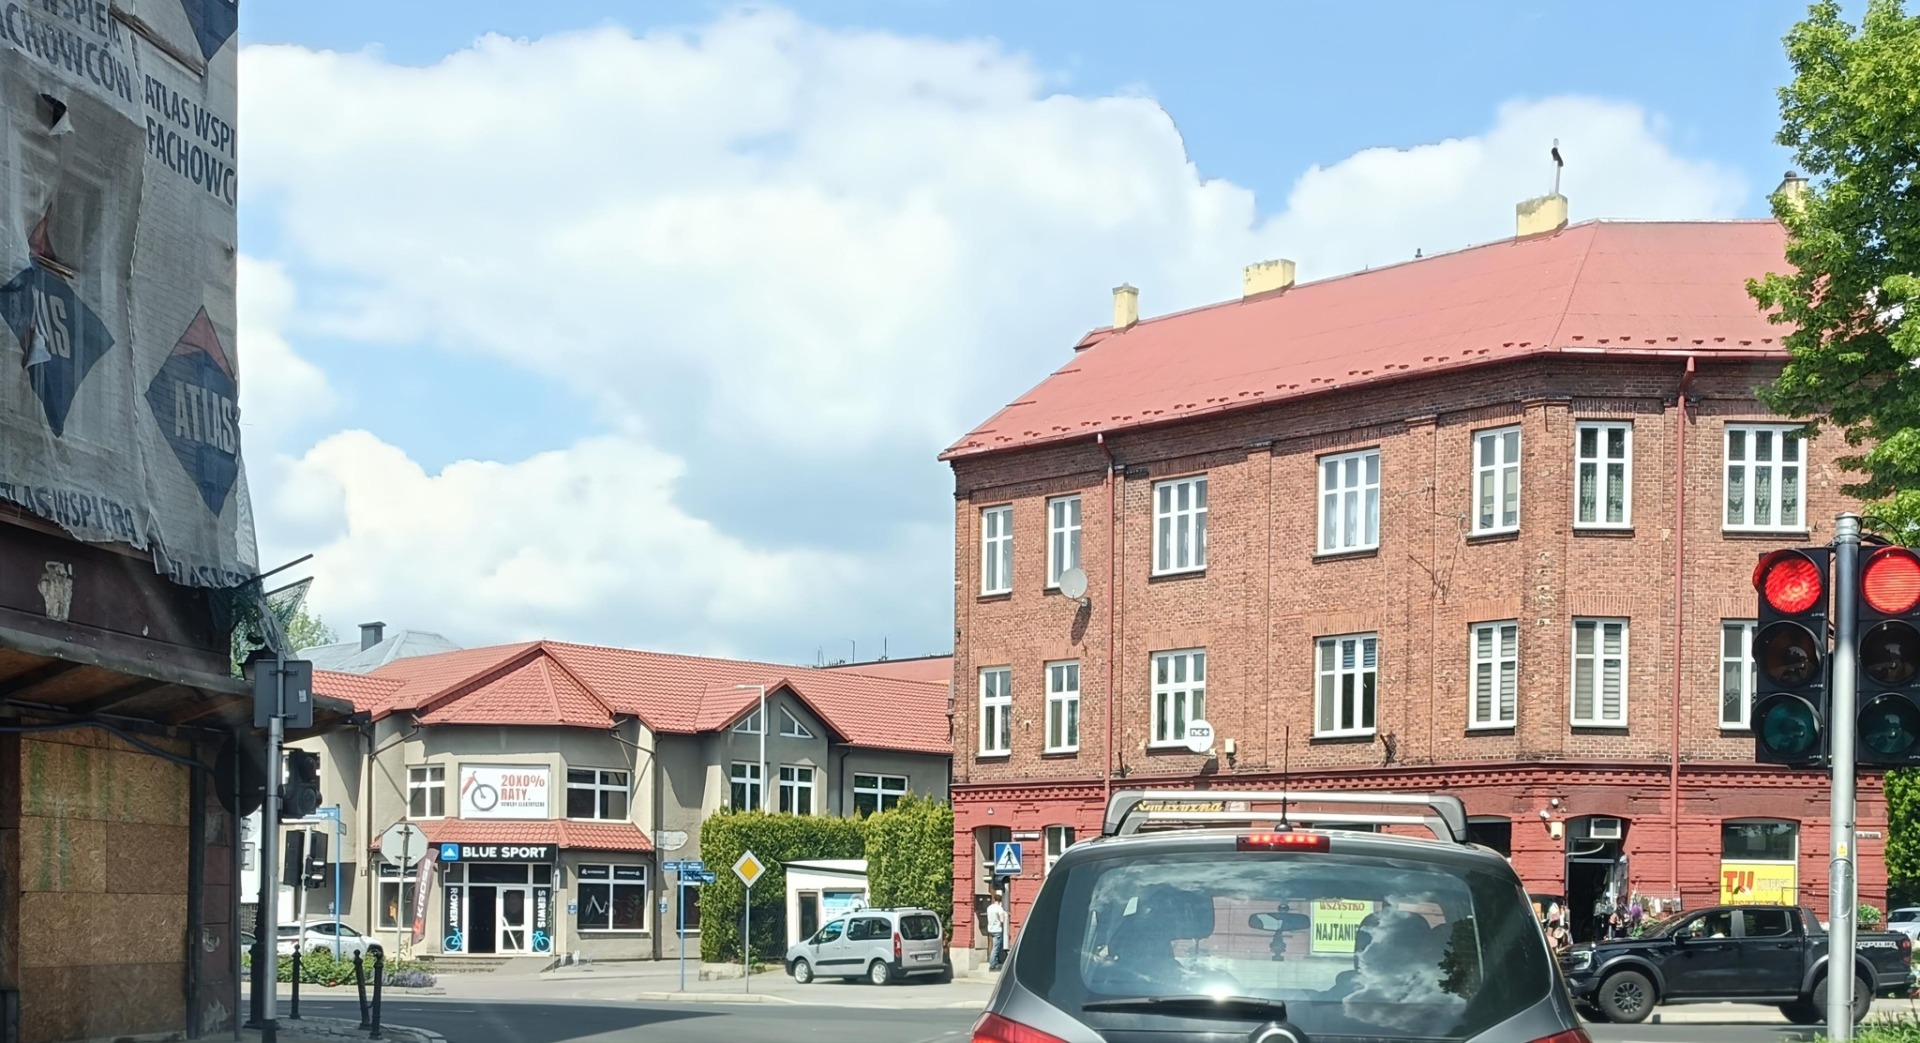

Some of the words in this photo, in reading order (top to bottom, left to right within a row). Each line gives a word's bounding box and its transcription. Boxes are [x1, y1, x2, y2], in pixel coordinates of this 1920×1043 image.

[145, 74, 190, 129] ATLAS
[146, 115, 237, 206] FACHOWC
[175, 381, 236, 455] ATLAS
[462, 846, 497, 858] BLUE
[501, 847, 547, 858] SPORT
[416, 858, 431, 918] KROSS
[1723, 871, 1754, 893] TU
[449, 887, 459, 928] ROWERY
[537, 890, 546, 928] SERWIS
[1320, 901, 1365, 911] WSZYSTKO
